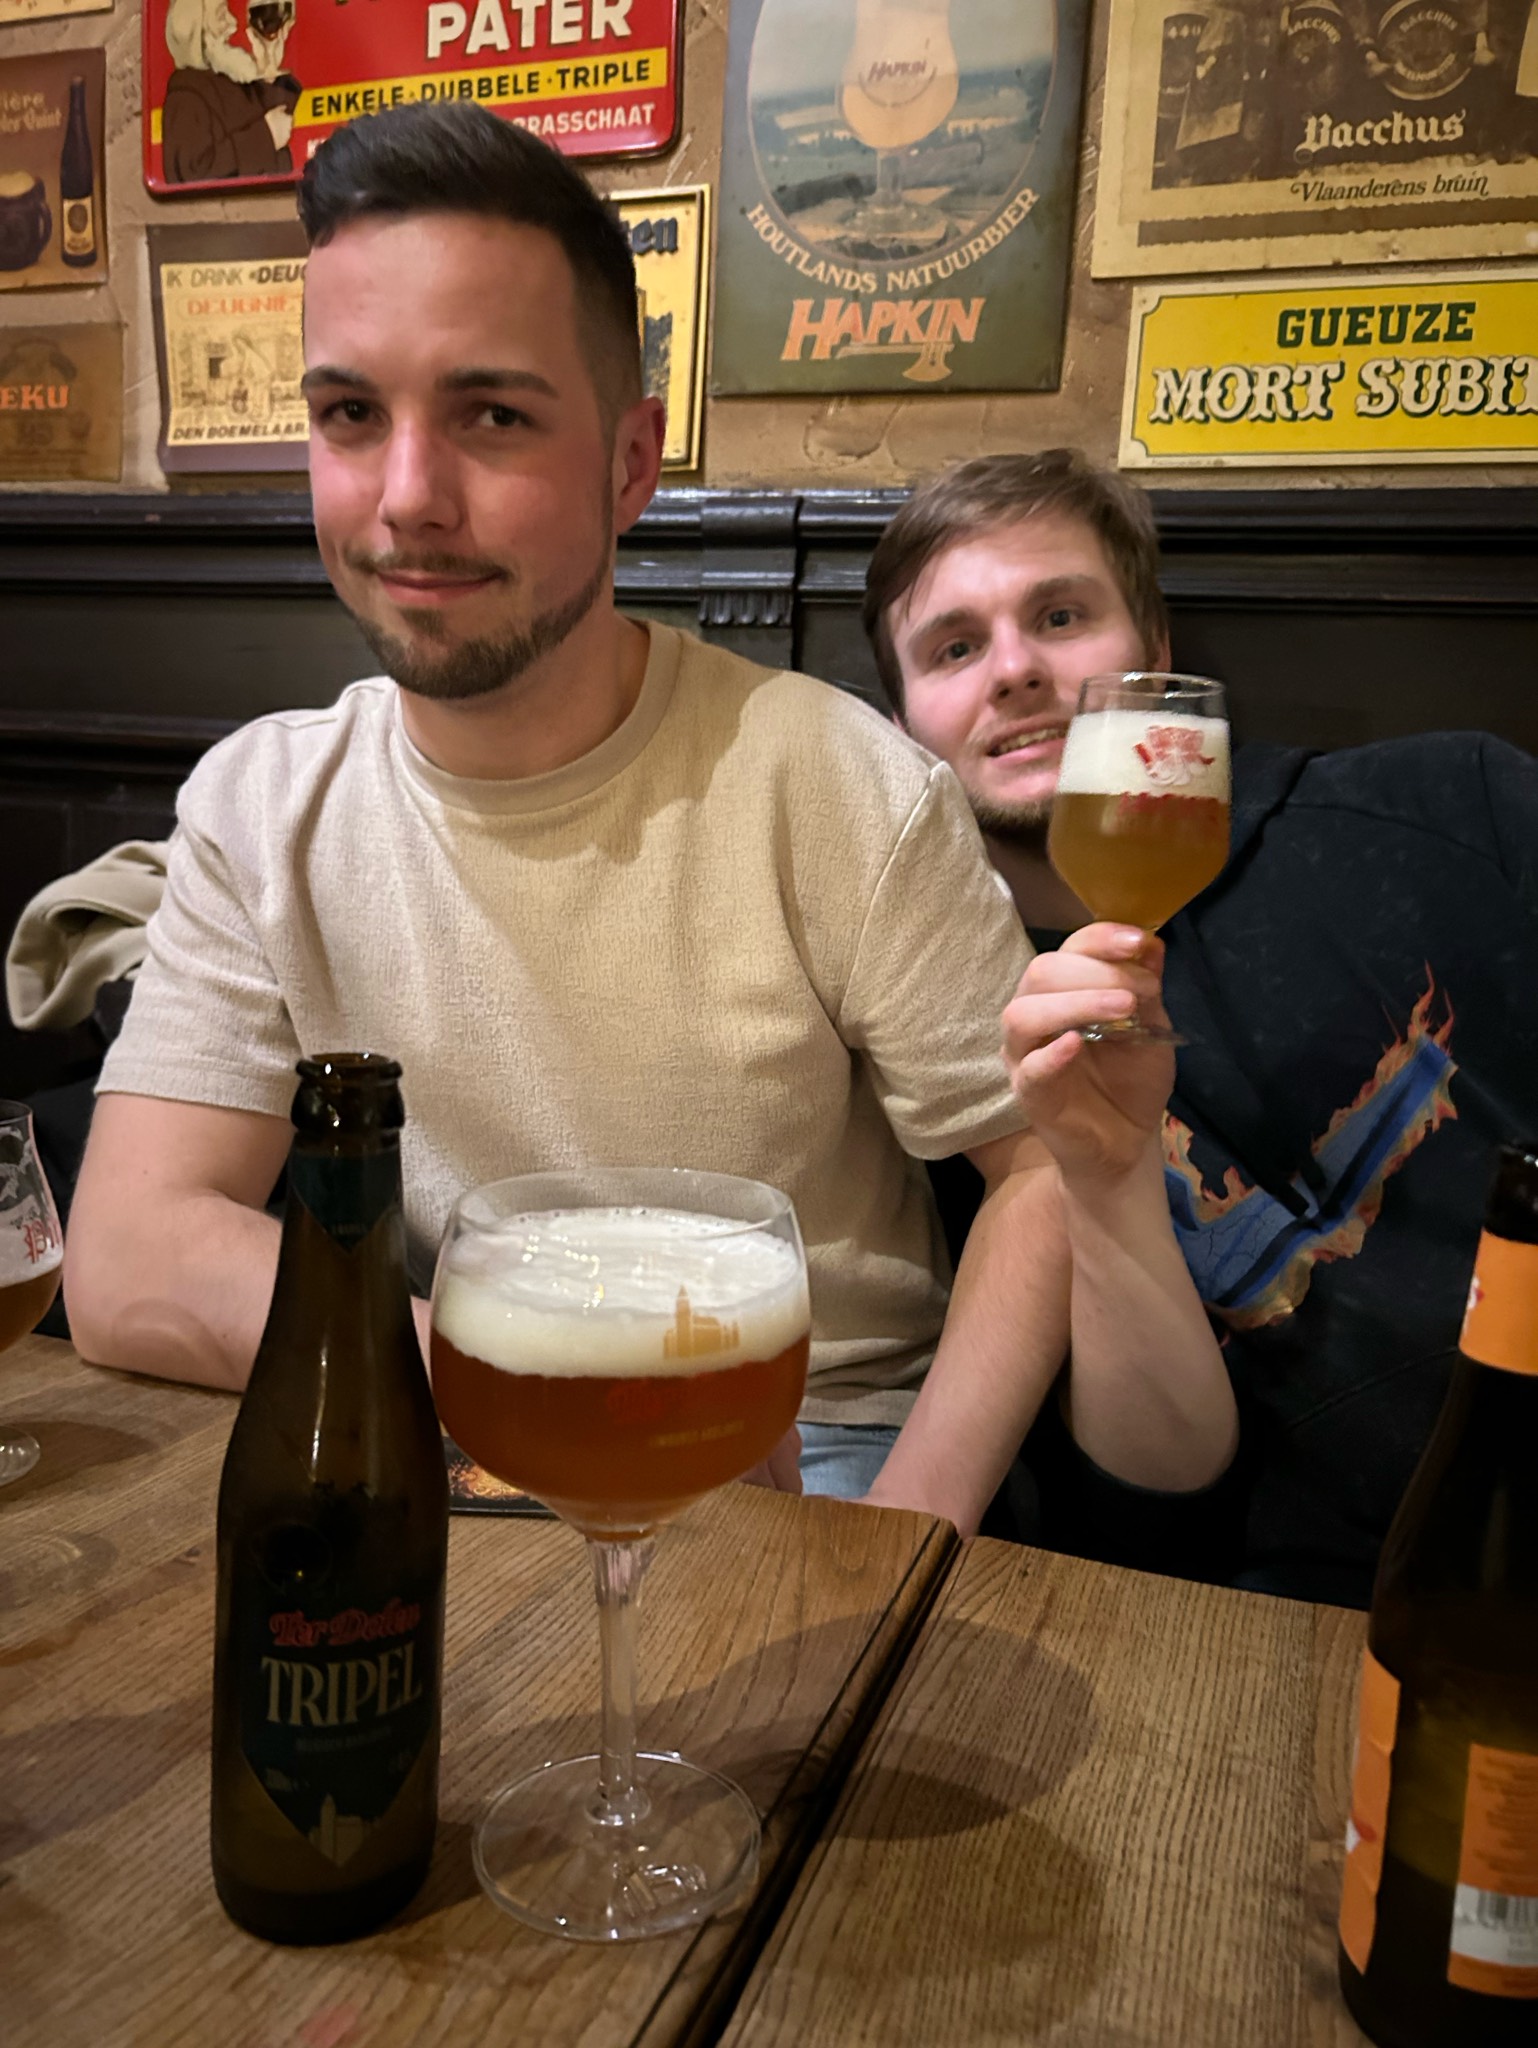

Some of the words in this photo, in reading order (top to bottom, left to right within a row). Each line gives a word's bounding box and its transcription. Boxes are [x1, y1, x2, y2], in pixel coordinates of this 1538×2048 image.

[427, 0, 633, 59] PATER
[311, 86, 405, 118] ENKELE
[421, 71, 540, 104] DUBBELE
[555, 59, 650, 91] TRIPLE
[1294, 107, 1467, 164] Bacchus
[1290, 178, 1427, 202] Vlaanderens
[618, 217, 678, 257] en
[746, 203, 878, 293] HOUTLANDS
[886, 187, 1041, 293] NATUURBIER
[780, 297, 987, 361] HAPKIN
[1276, 301, 1477, 348] GUEUZE
[1148, 360, 1346, 425] MORT
[261, 1642, 423, 1726] TRIPEL
